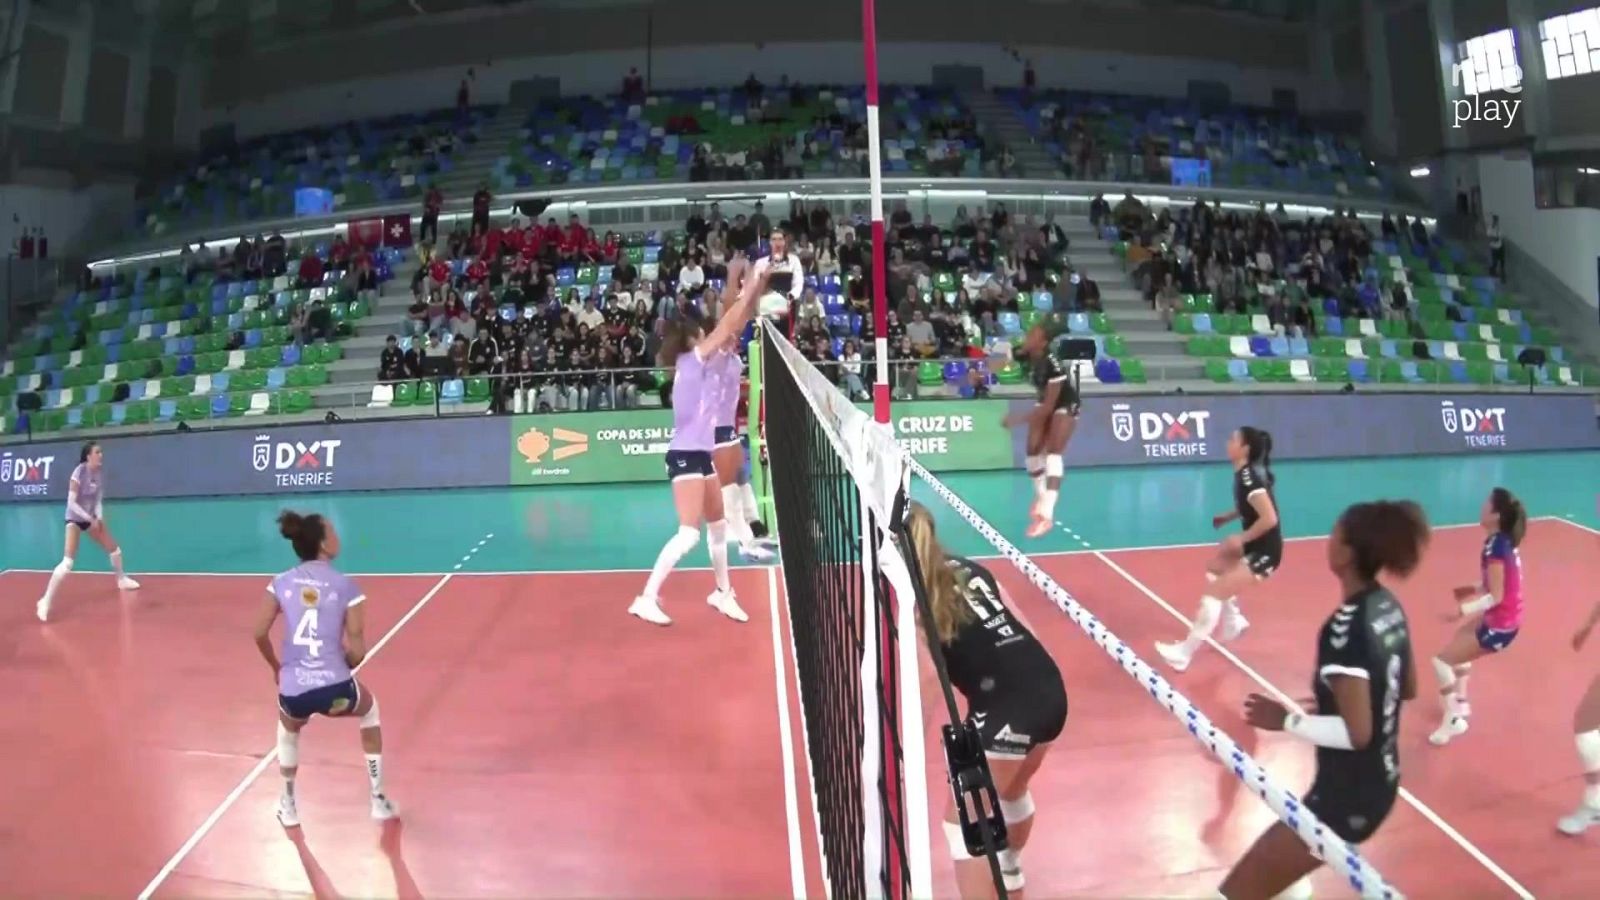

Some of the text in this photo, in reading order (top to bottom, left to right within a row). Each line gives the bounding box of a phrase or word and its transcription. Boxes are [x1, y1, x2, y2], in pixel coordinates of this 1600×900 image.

[898, 415, 974, 433] CRUZ DE
[1140, 411, 1210, 441] DXT
[1460, 407, 1505, 432] DXT
[596, 428, 627, 441] COPA
[629, 429, 643, 440] DE
[645, 427, 662, 440] SM
[1465, 435, 1506, 446] TENERIFE
[896, 437, 948, 454] ERIFE
[1143, 442, 1208, 457] TENERIFE
[275, 440, 341, 470] DXT
[14, 456, 55, 481] DXT
[275, 472, 333, 487] TENERIFE
[292, 608, 324, 658] 4
